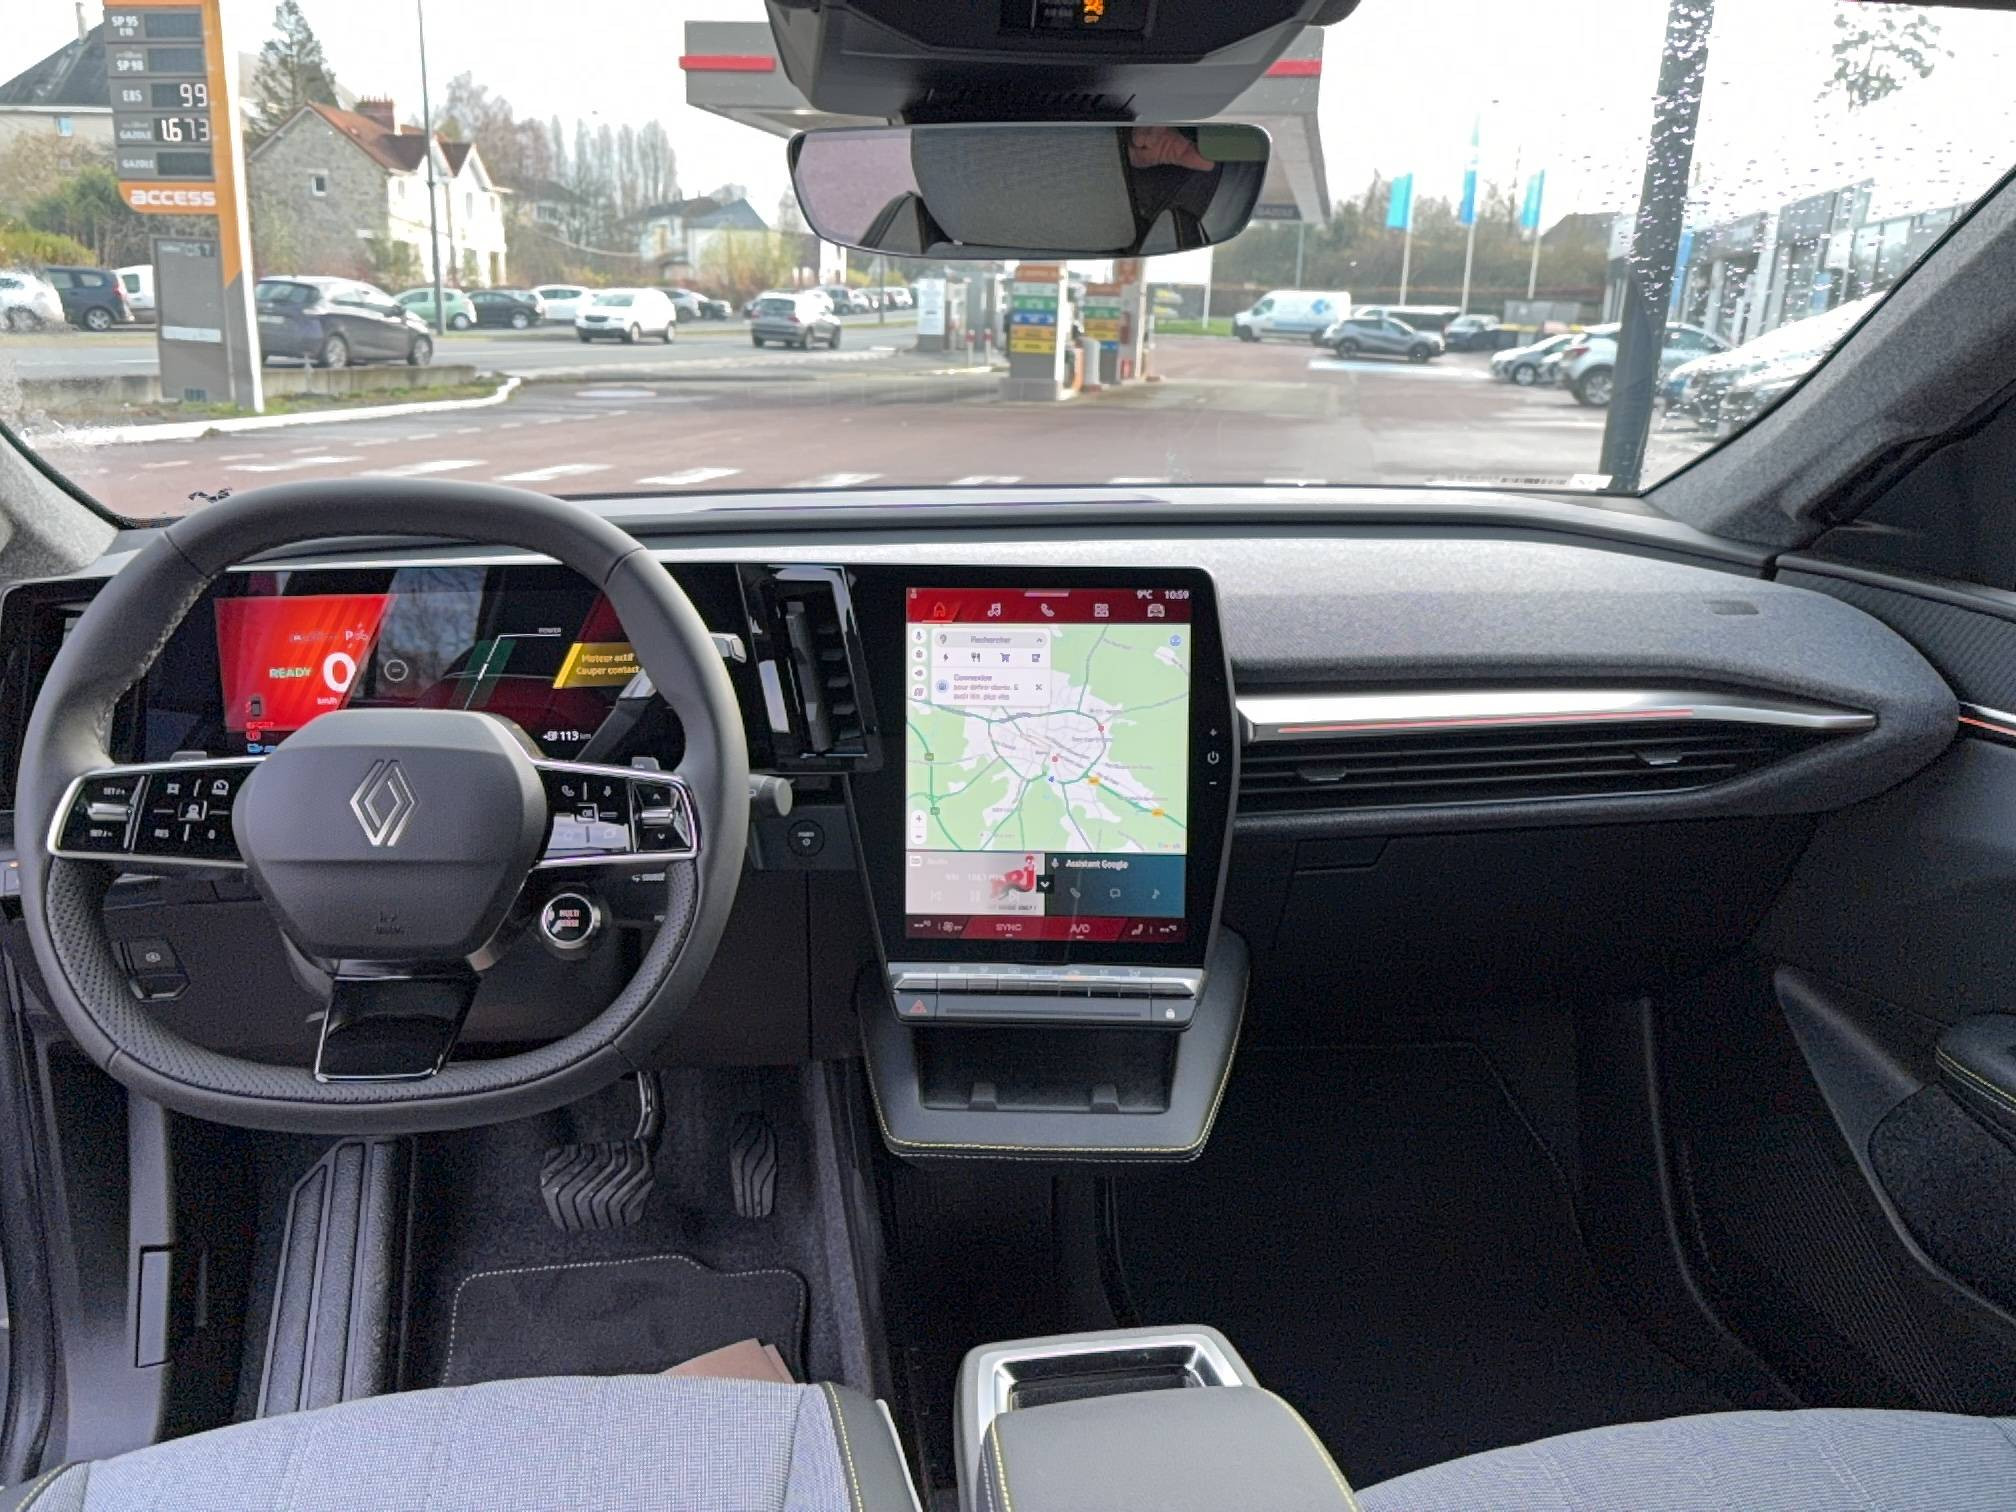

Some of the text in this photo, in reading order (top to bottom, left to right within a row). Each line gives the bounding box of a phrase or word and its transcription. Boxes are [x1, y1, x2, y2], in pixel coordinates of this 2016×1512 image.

[180, 84, 208, 107] 99
[130, 189, 216, 207] access
[1164, 590, 1190, 600] 10:59
[269, 667, 312, 679] READY
[323, 652, 357, 693] 0
[560, 731, 579, 741] 113
[1065, 859, 1129, 870] Assistant Google
[996, 923, 1022, 932] SYNC
[1070, 924, 1091, 933] A/C
